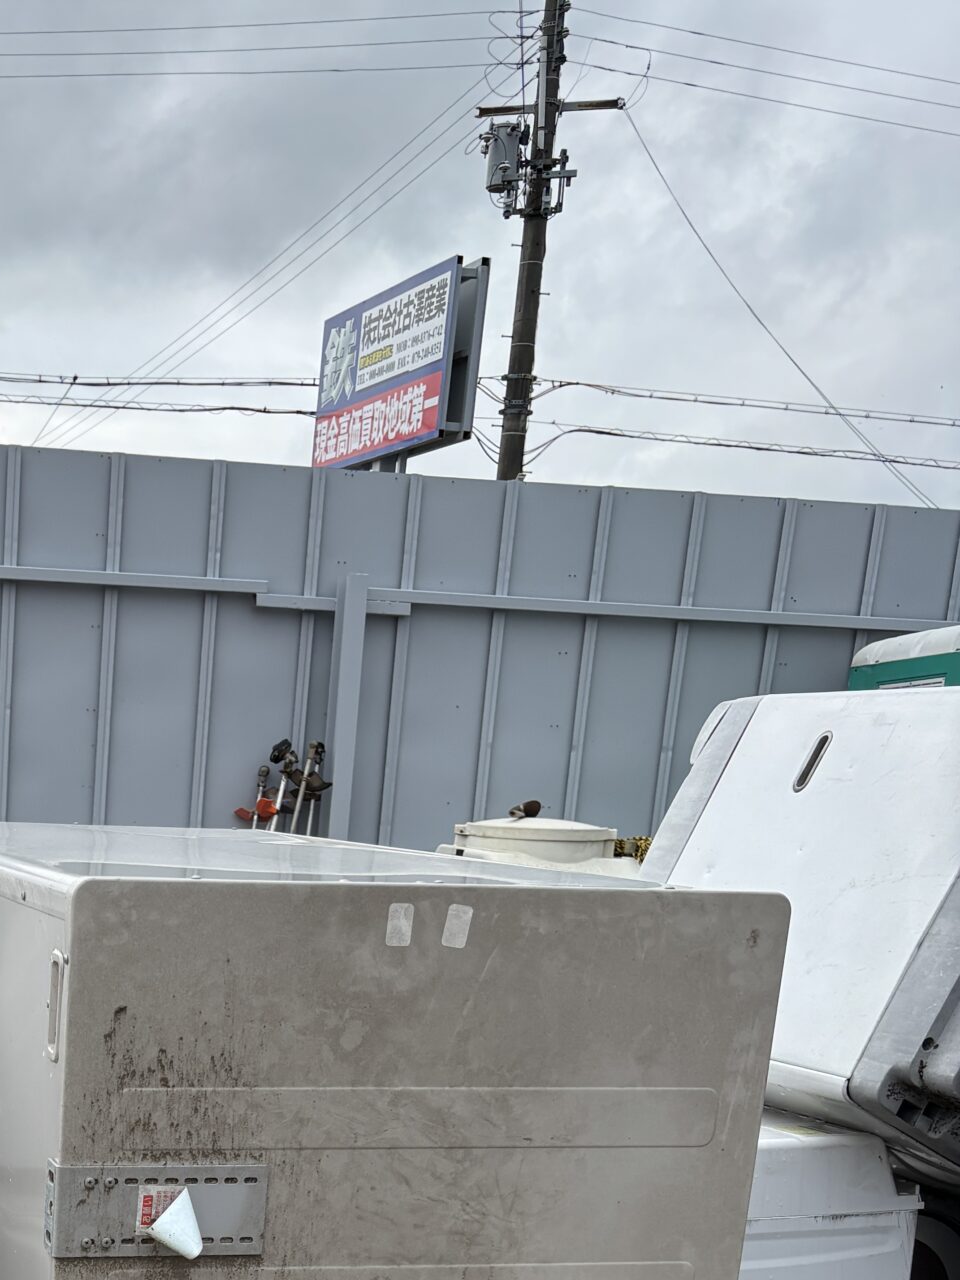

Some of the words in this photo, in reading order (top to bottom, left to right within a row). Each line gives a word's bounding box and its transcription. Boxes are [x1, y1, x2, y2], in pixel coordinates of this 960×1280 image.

[321, 317, 357, 408] 鉄
[314, 382, 440, 464] 現金高価買取地域第一
